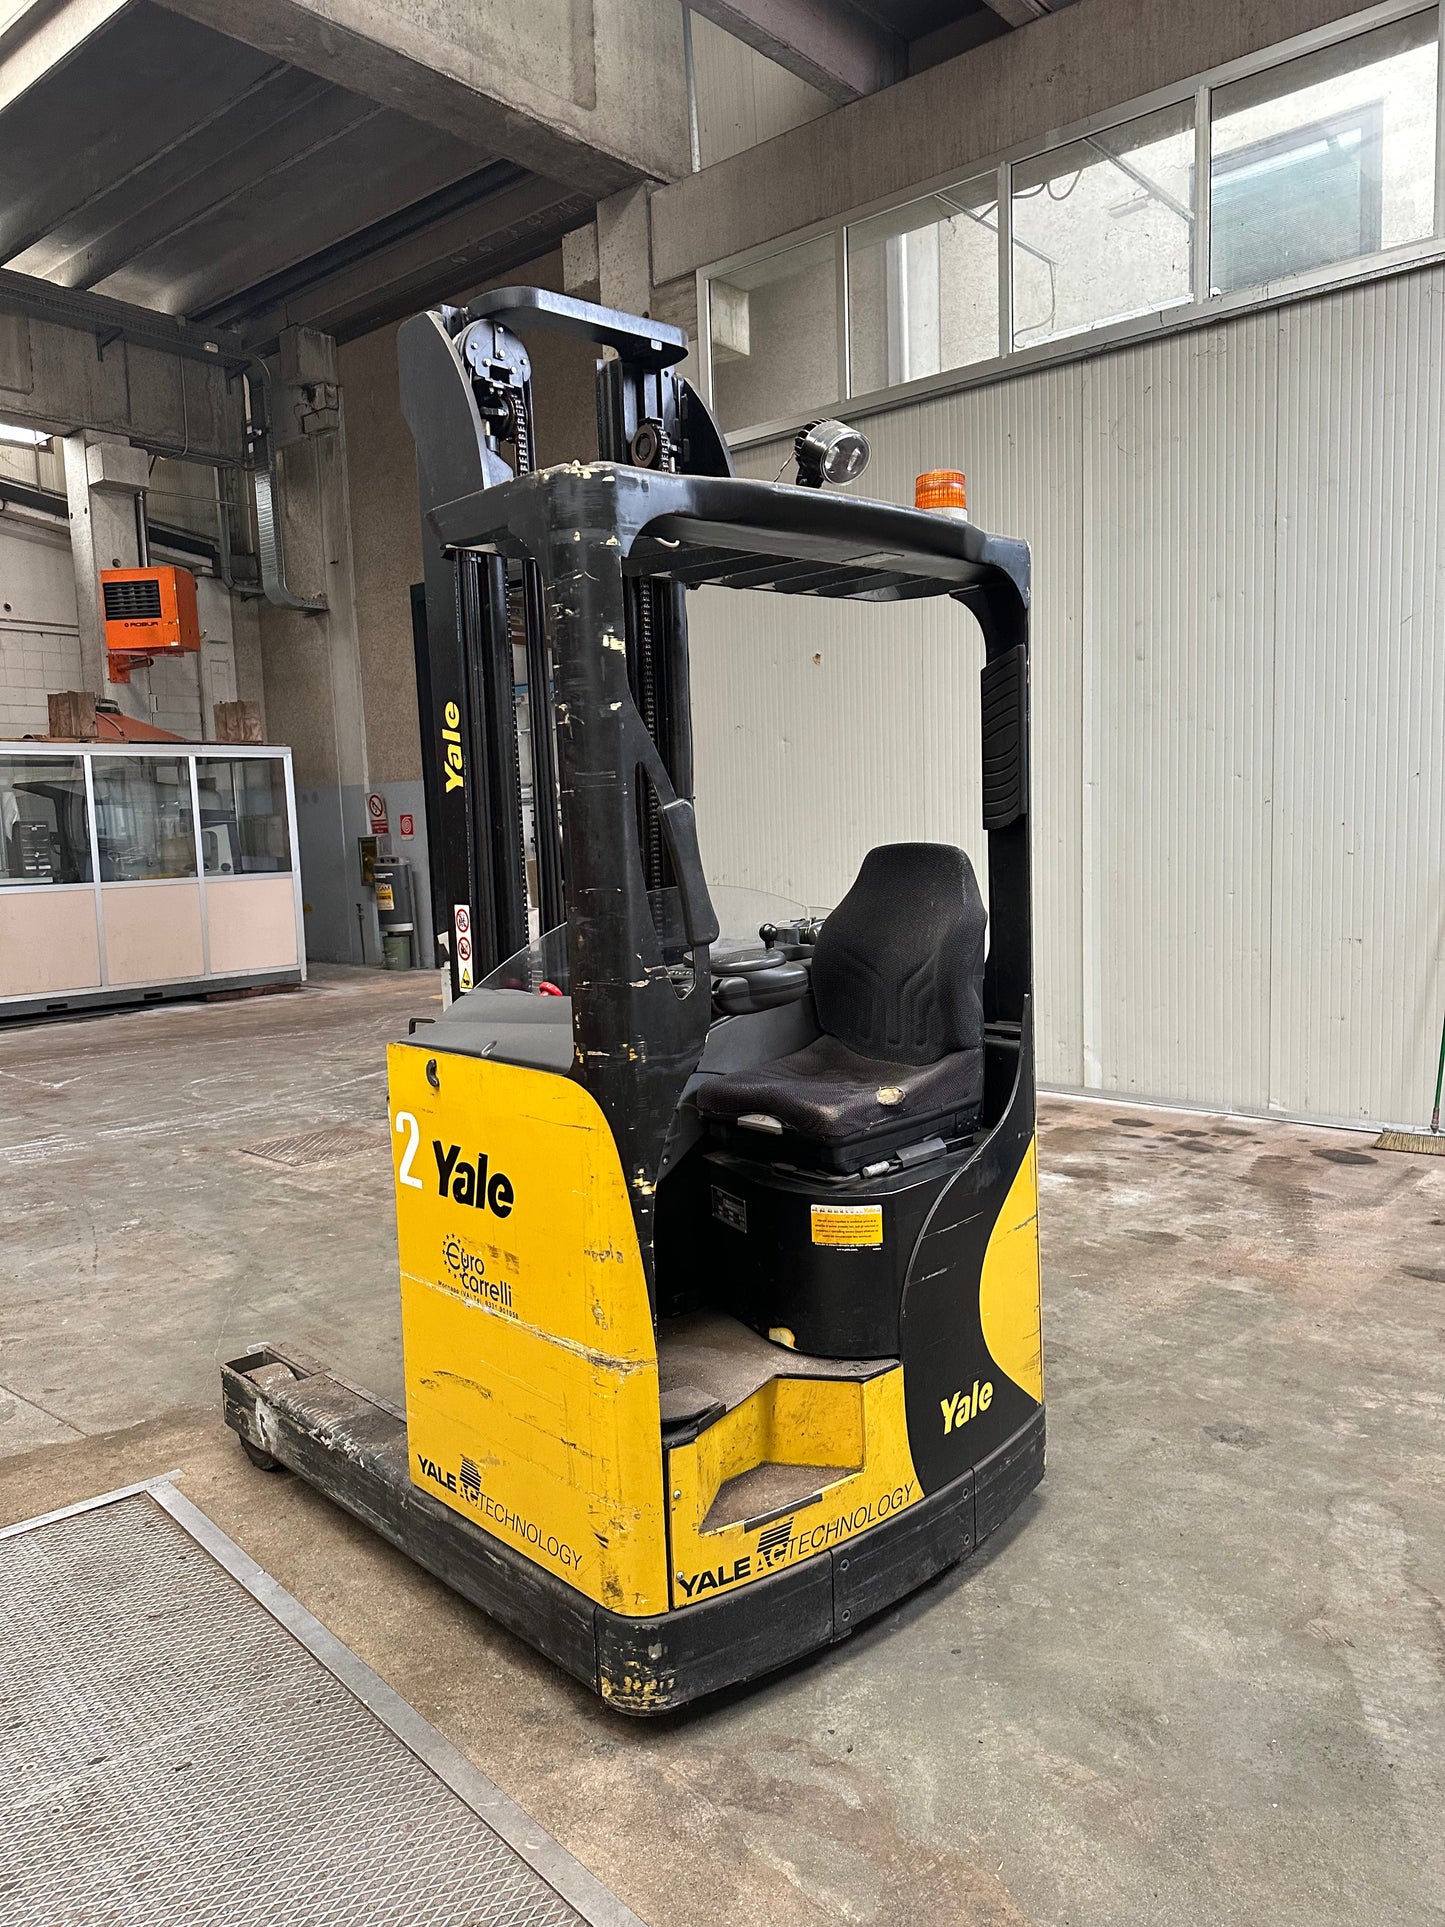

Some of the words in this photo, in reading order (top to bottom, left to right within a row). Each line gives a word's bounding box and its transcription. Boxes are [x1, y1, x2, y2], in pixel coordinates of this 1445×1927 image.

[442, 701, 464, 793] Yale
[395, 1111, 423, 1189] 2
[432, 1140, 515, 1219] Yale
[461, 1272, 512, 1307] carrelli
[940, 1379, 995, 1435] Yale
[416, 1453, 457, 1495] YALE
[479, 1491, 583, 1571] TECHNOLOGY
[679, 1556, 751, 1598] YALE
[787, 1480, 915, 1559] TECHNOLOGY
